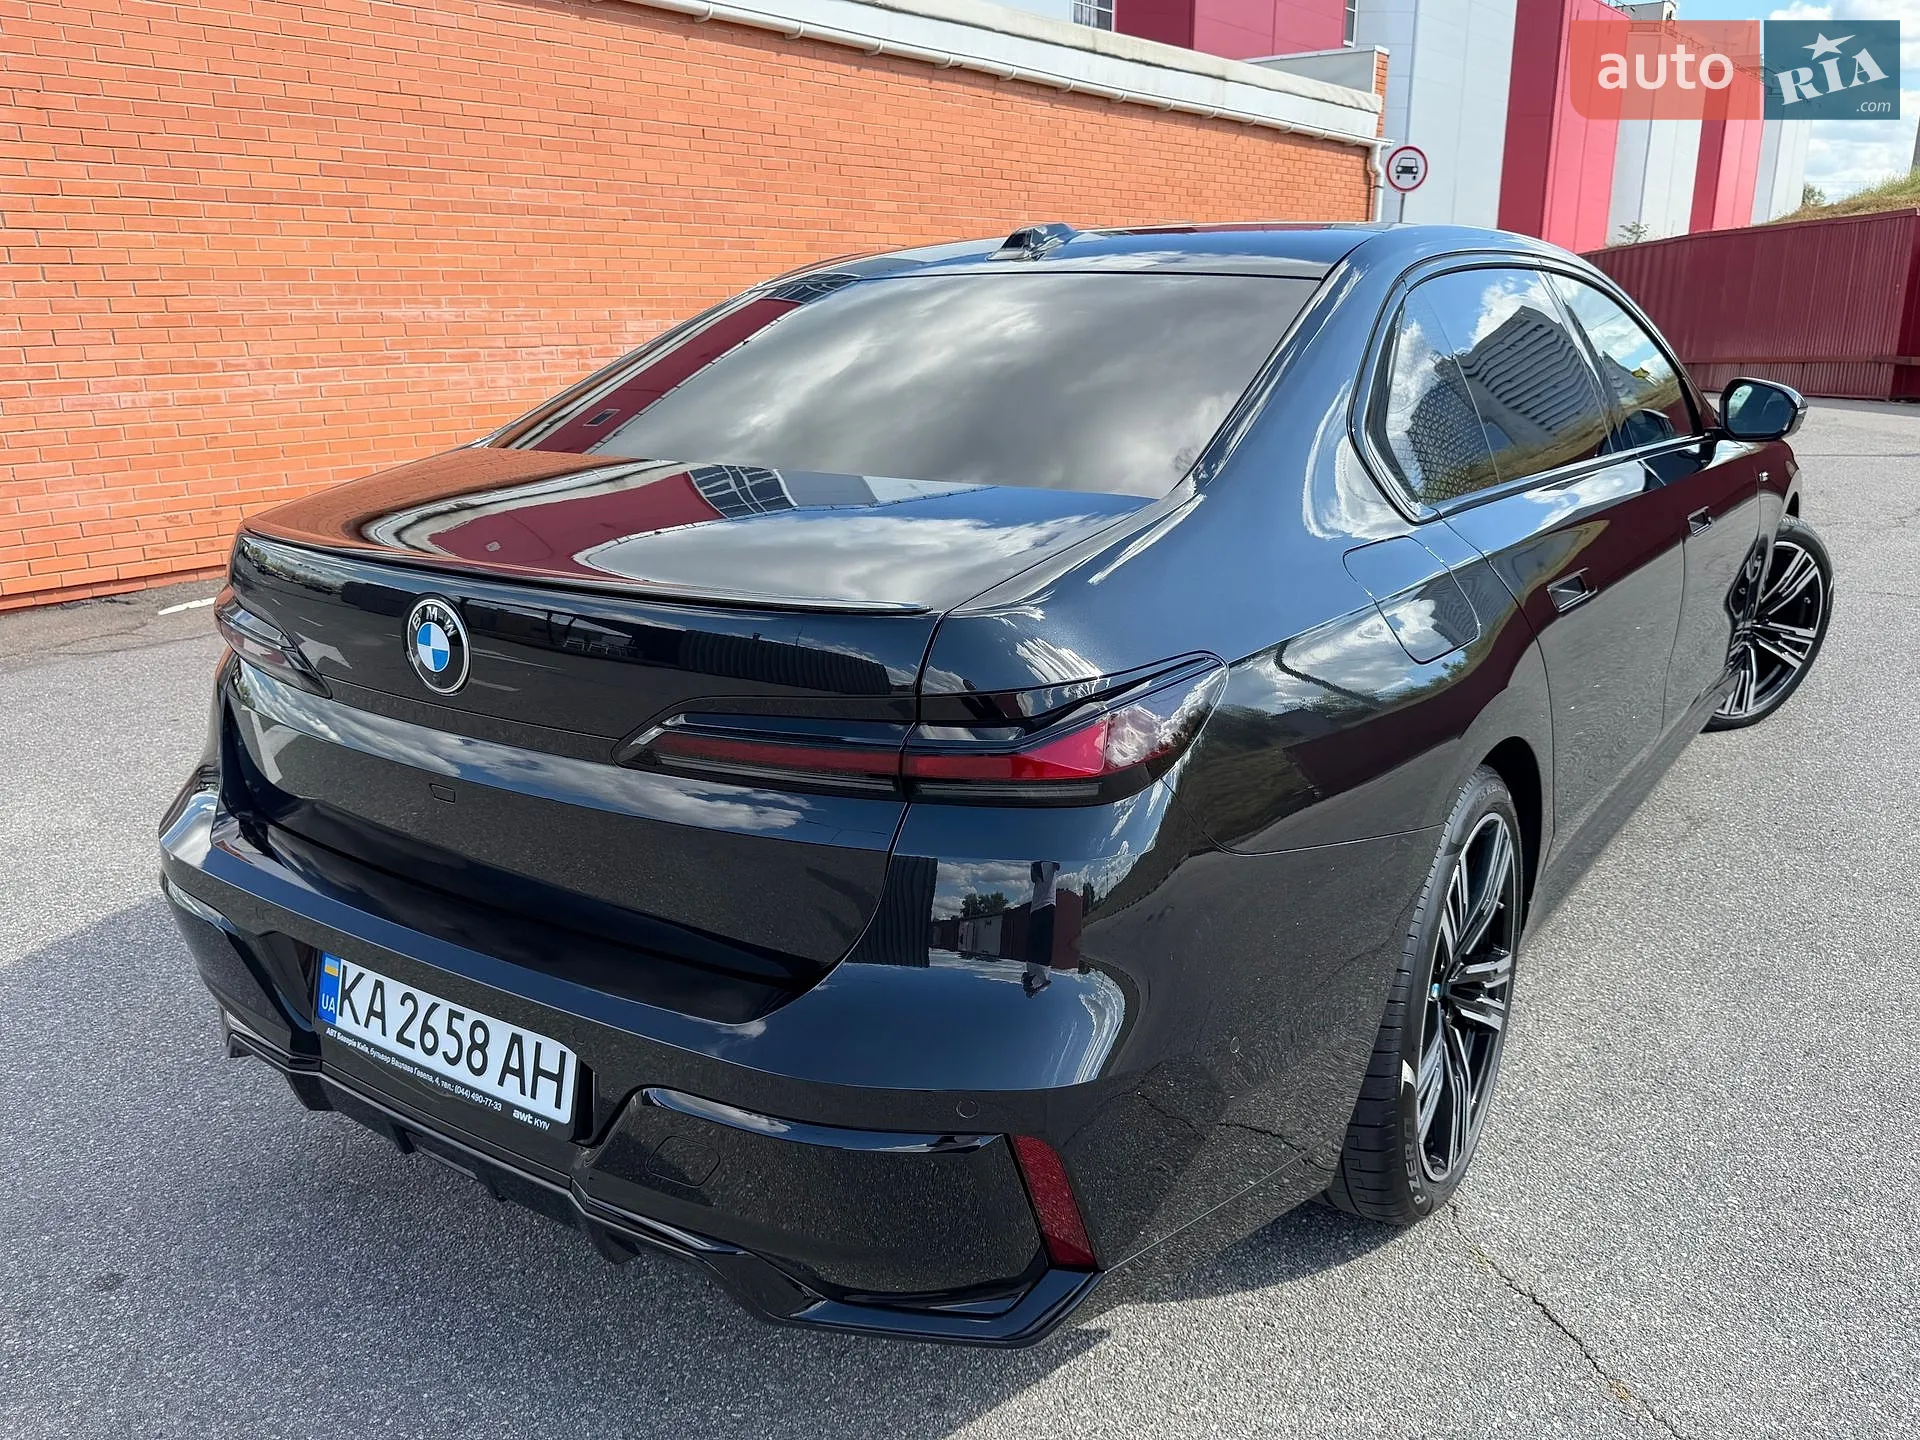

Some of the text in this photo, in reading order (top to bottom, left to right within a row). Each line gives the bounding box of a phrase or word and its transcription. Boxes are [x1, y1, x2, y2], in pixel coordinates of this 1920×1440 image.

[412, 605, 458, 637] BMW
[321, 993, 336, 1015] UA
[338, 965, 567, 1110] KA 2658 AH
[454, 1085, 471, 1099] (044)
[471, 1092, 502, 1112] 490-77-33
[512, 1109, 551, 1131] awt KYIV
[1414, 1194, 1427, 1205] P
